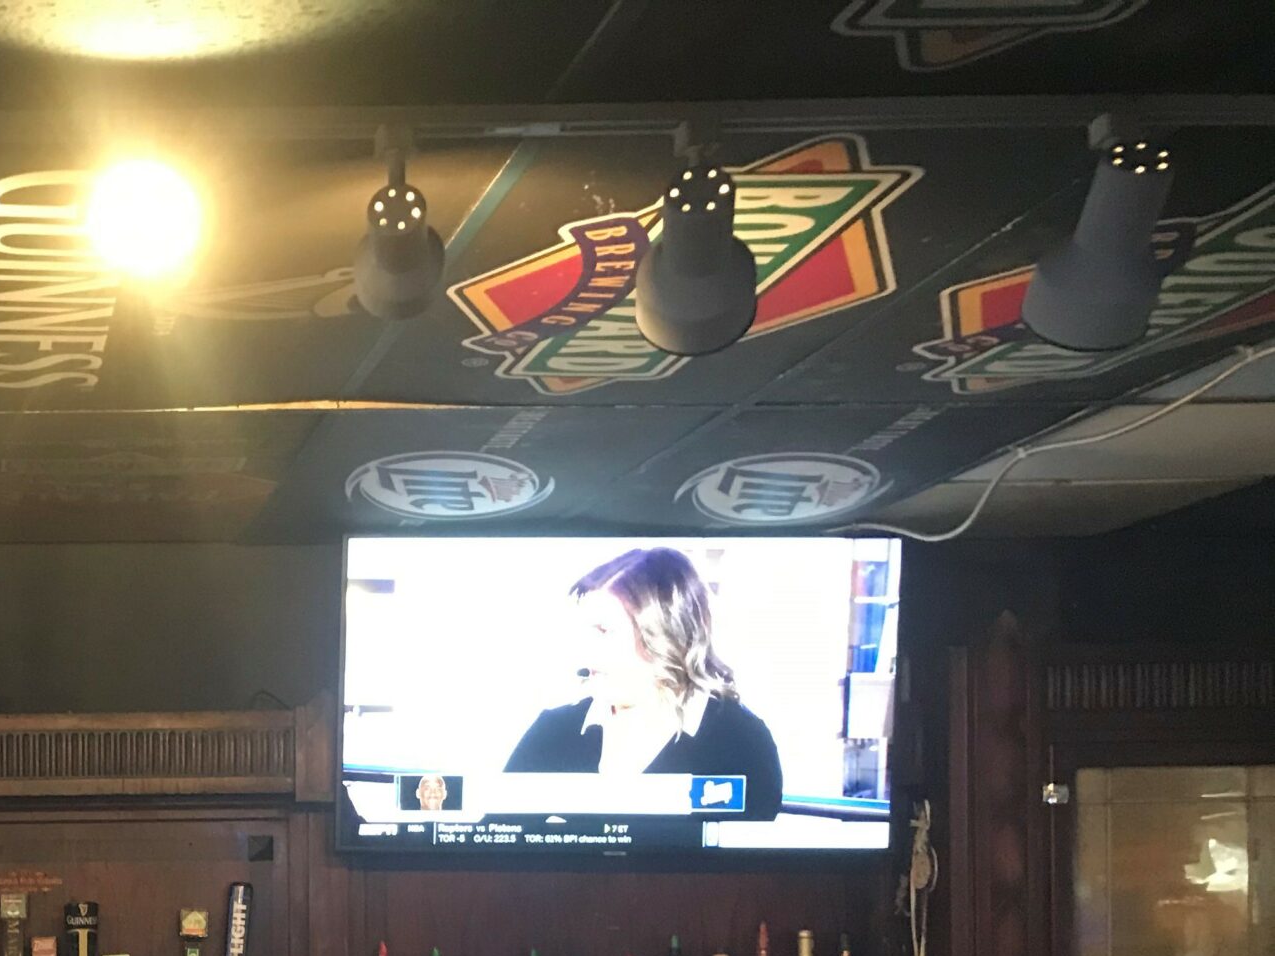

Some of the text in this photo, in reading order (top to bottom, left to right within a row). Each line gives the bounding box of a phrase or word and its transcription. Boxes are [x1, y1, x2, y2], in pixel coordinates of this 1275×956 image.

[540, 222, 637, 330] BREWING
[438, 824, 473, 834] Raptors
[488, 824, 523, 833] Pistons
[438, 834, 455, 843] TOR
[66, 915, 99, 926] GUINNE
[231, 901, 247, 956] LIGHT
